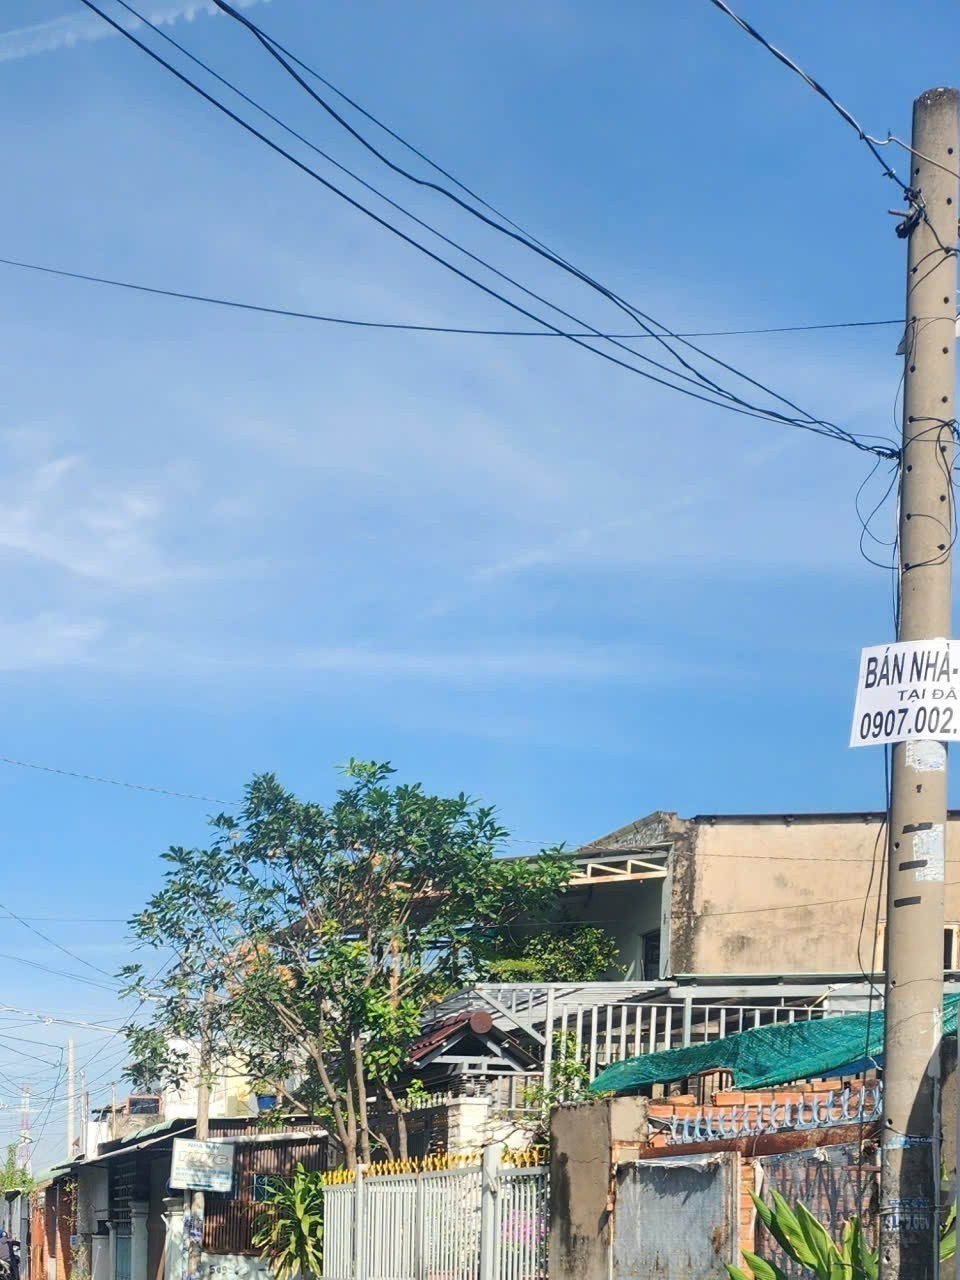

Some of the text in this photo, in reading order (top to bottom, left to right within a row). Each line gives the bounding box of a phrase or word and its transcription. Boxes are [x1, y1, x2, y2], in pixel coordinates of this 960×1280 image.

[865, 646, 905, 688] BÁN
[897, 686, 960, 703] TẠI ĐÂ
